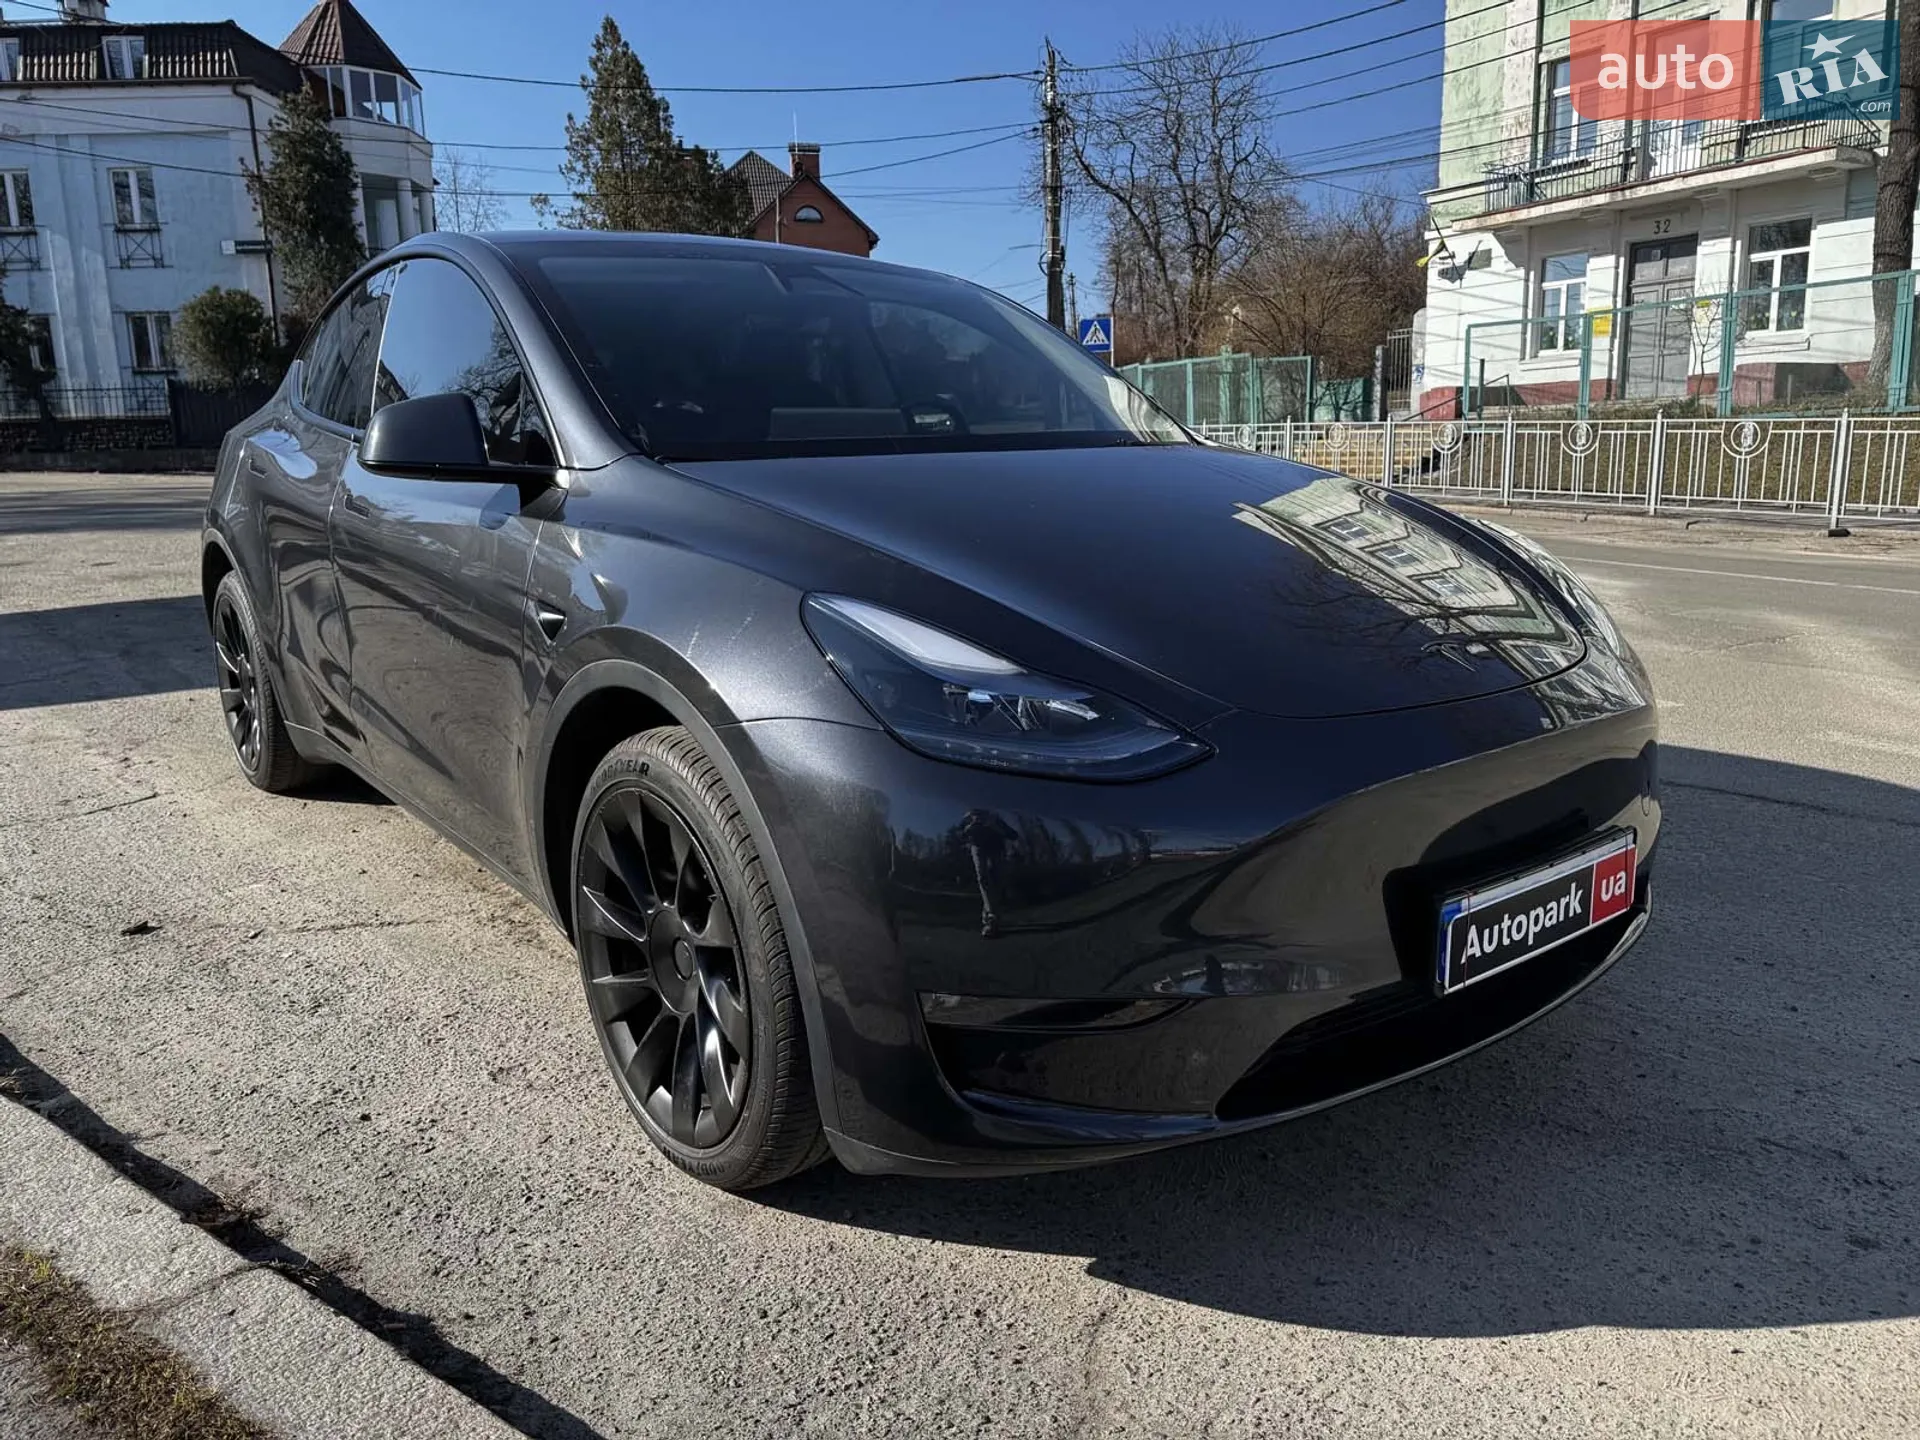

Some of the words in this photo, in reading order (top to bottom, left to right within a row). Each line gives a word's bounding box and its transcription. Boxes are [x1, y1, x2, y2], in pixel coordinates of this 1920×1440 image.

[1653, 218, 1672, 235] 32
[1460, 881, 1584, 965] Autopark
[1600, 870, 1627, 902] ua
